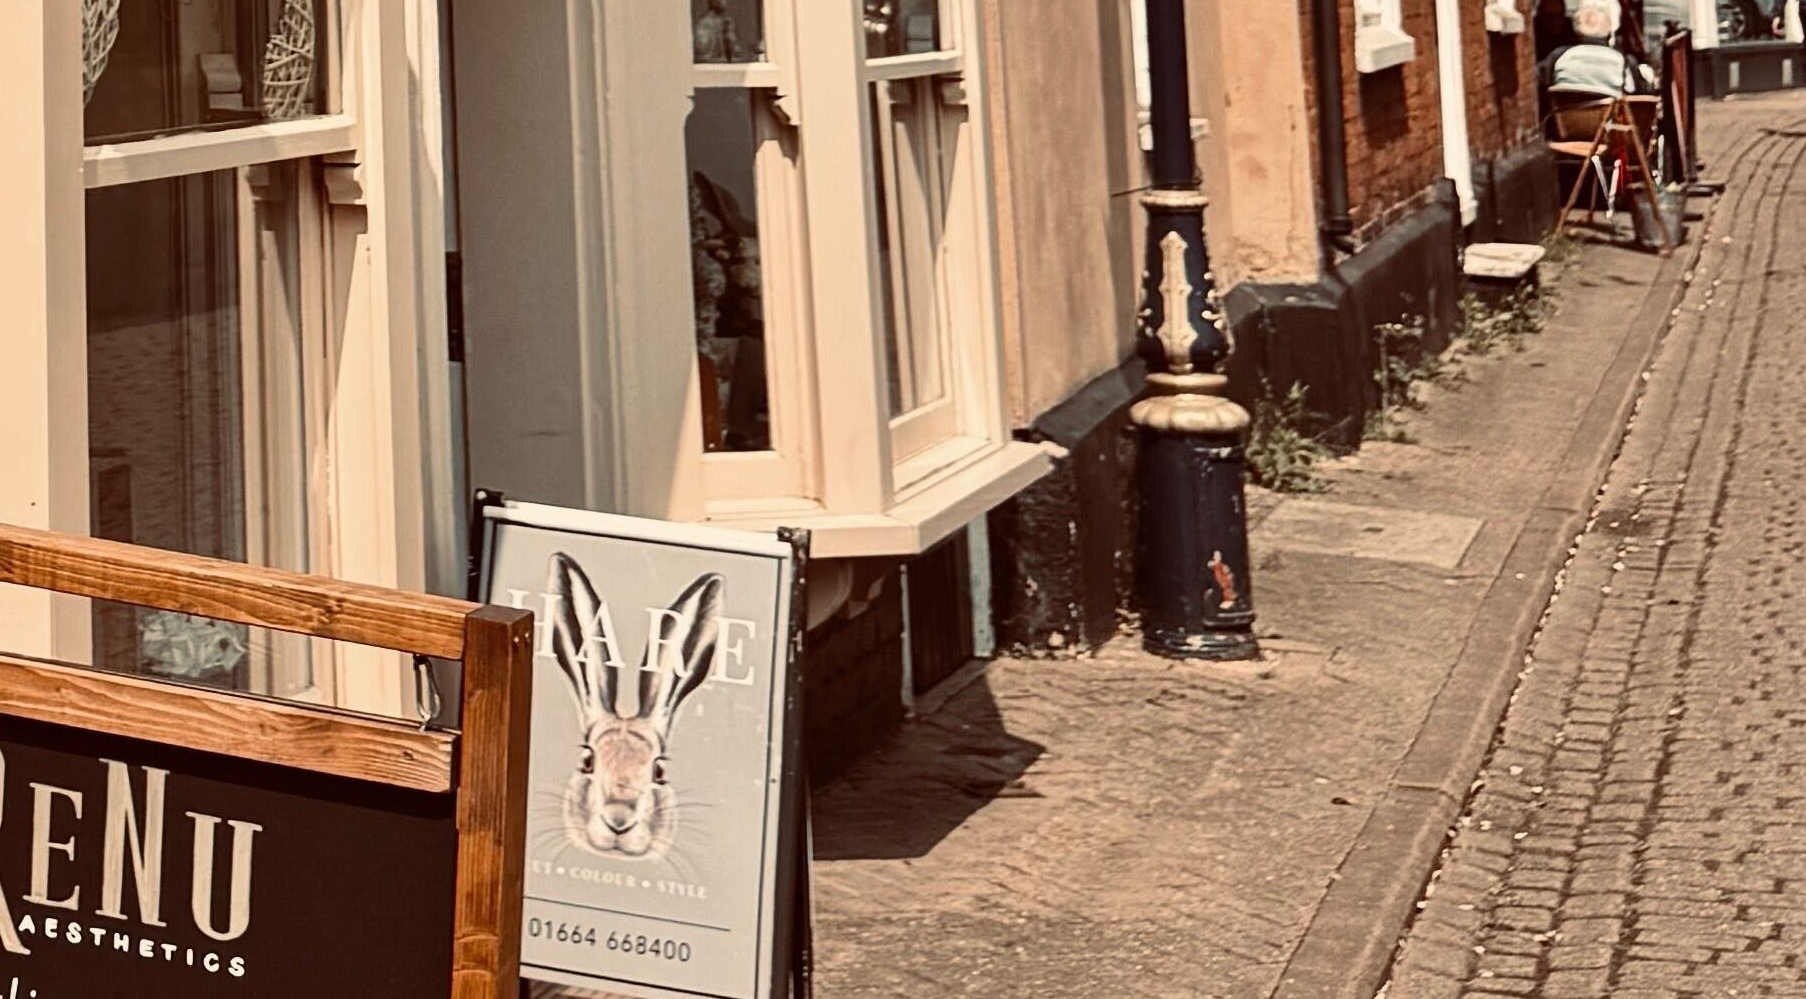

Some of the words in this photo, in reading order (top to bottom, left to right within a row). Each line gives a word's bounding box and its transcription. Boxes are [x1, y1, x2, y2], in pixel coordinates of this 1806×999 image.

[508, 588, 756, 686] HARE
[569, 866, 636, 888] COLOUR
[657, 879, 707, 900] STYLE
[18, 915, 245, 977] AESTHETICS
[529, 917, 596, 946] 01664
[606, 930, 691, 962] 668400
